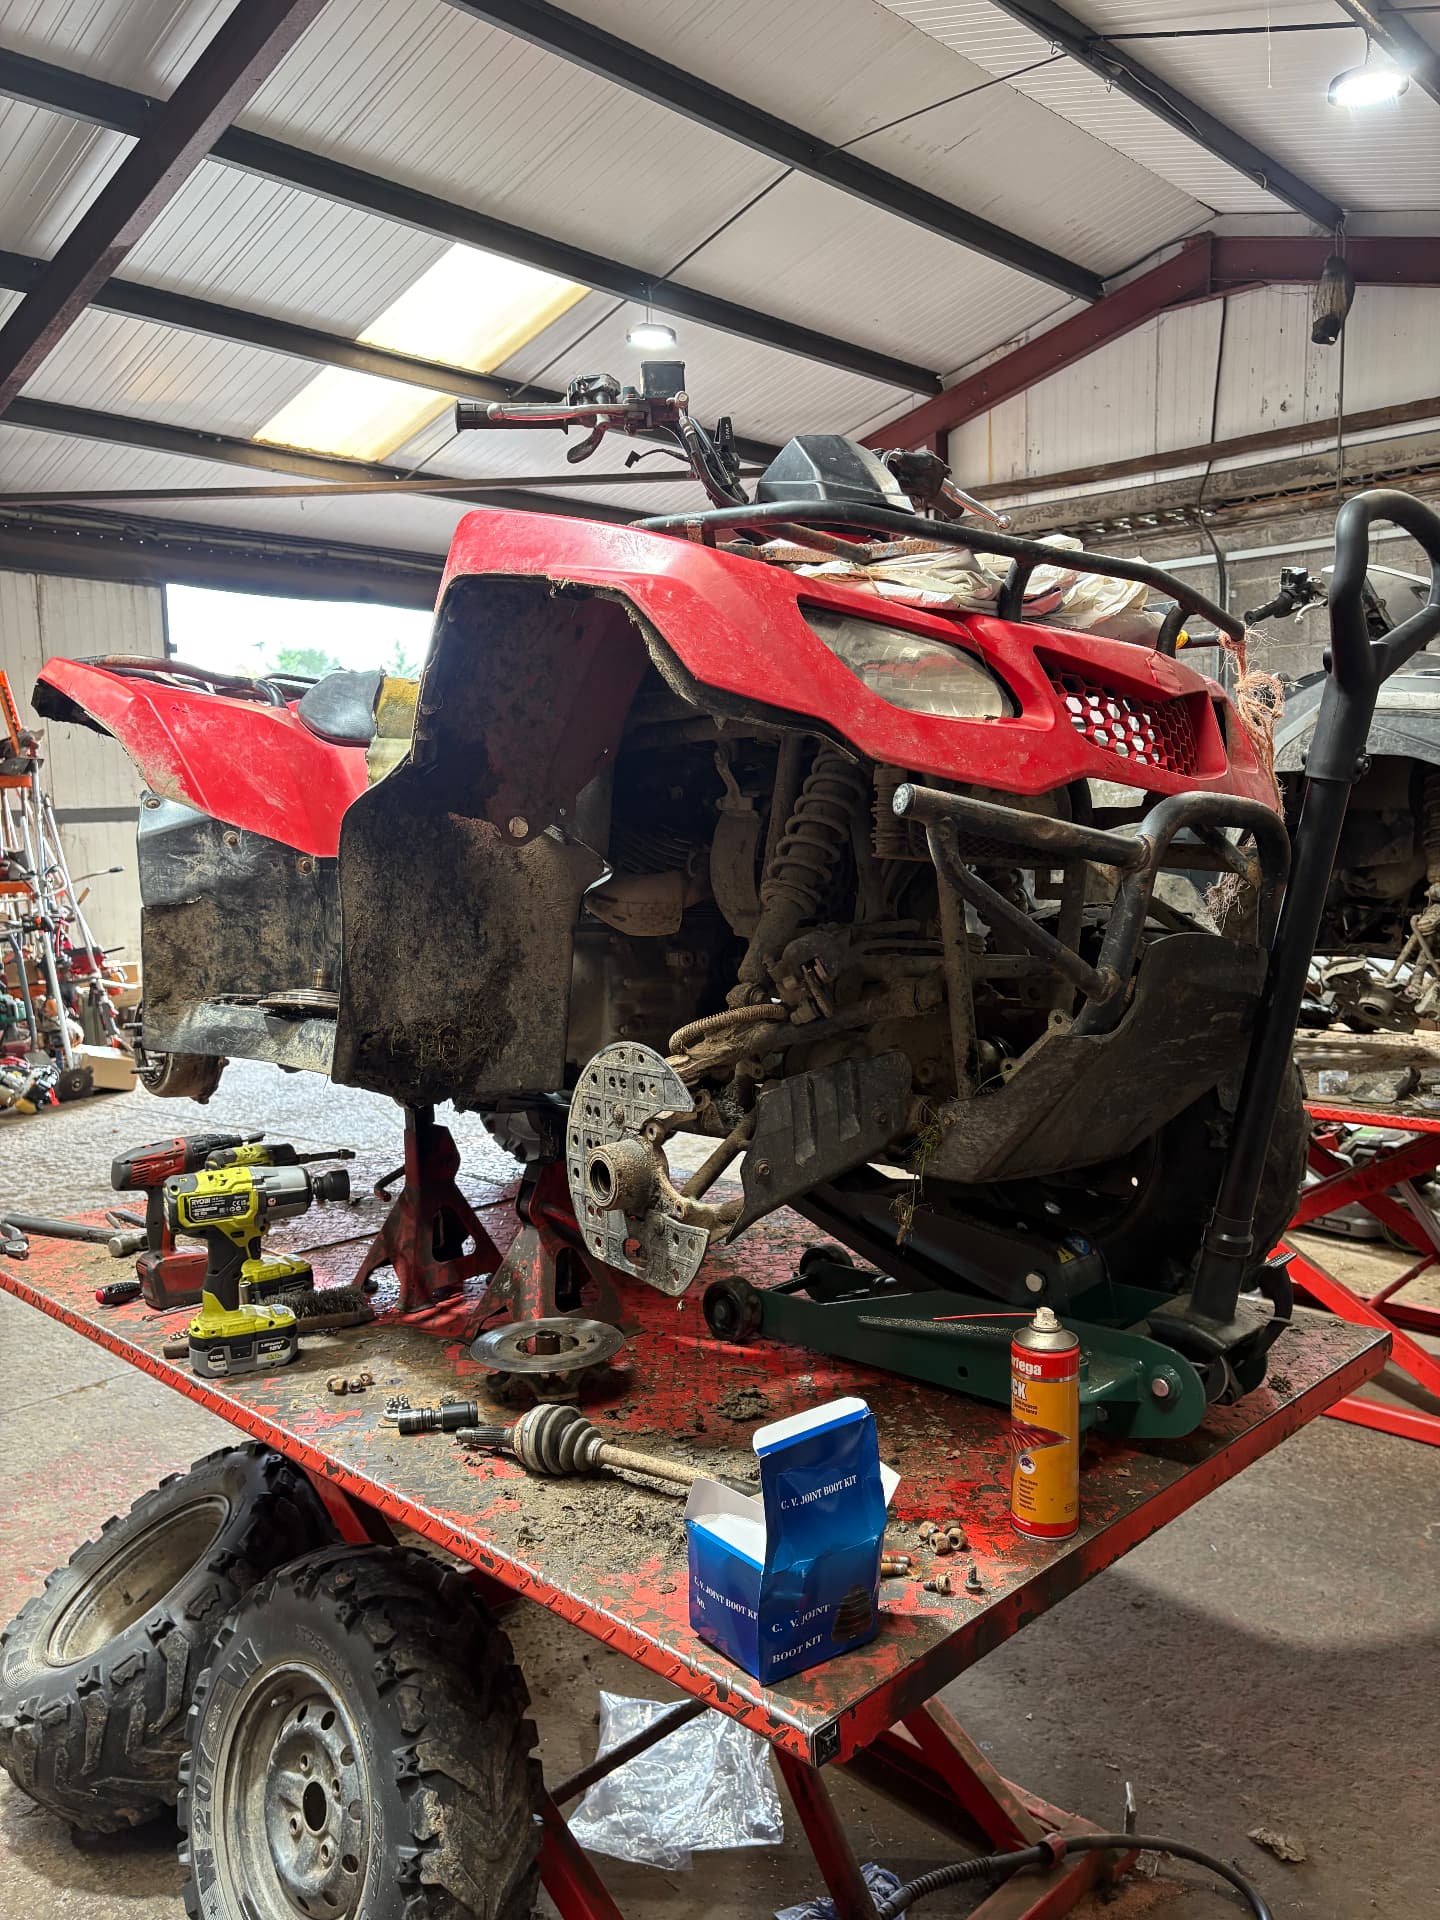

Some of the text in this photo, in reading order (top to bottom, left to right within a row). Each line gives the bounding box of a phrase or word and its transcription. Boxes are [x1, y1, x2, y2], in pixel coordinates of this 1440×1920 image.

[800, 1488, 822, 1505] JOINT
[823, 1480, 843, 1496] BOOT
[843, 1474, 857, 1488] KIT
[725, 1598, 747, 1615] BOOT
[771, 1623, 783, 1633] C.
[800, 1604, 831, 1626] JOINT
[772, 1633, 823, 1664] BOOT KIT
